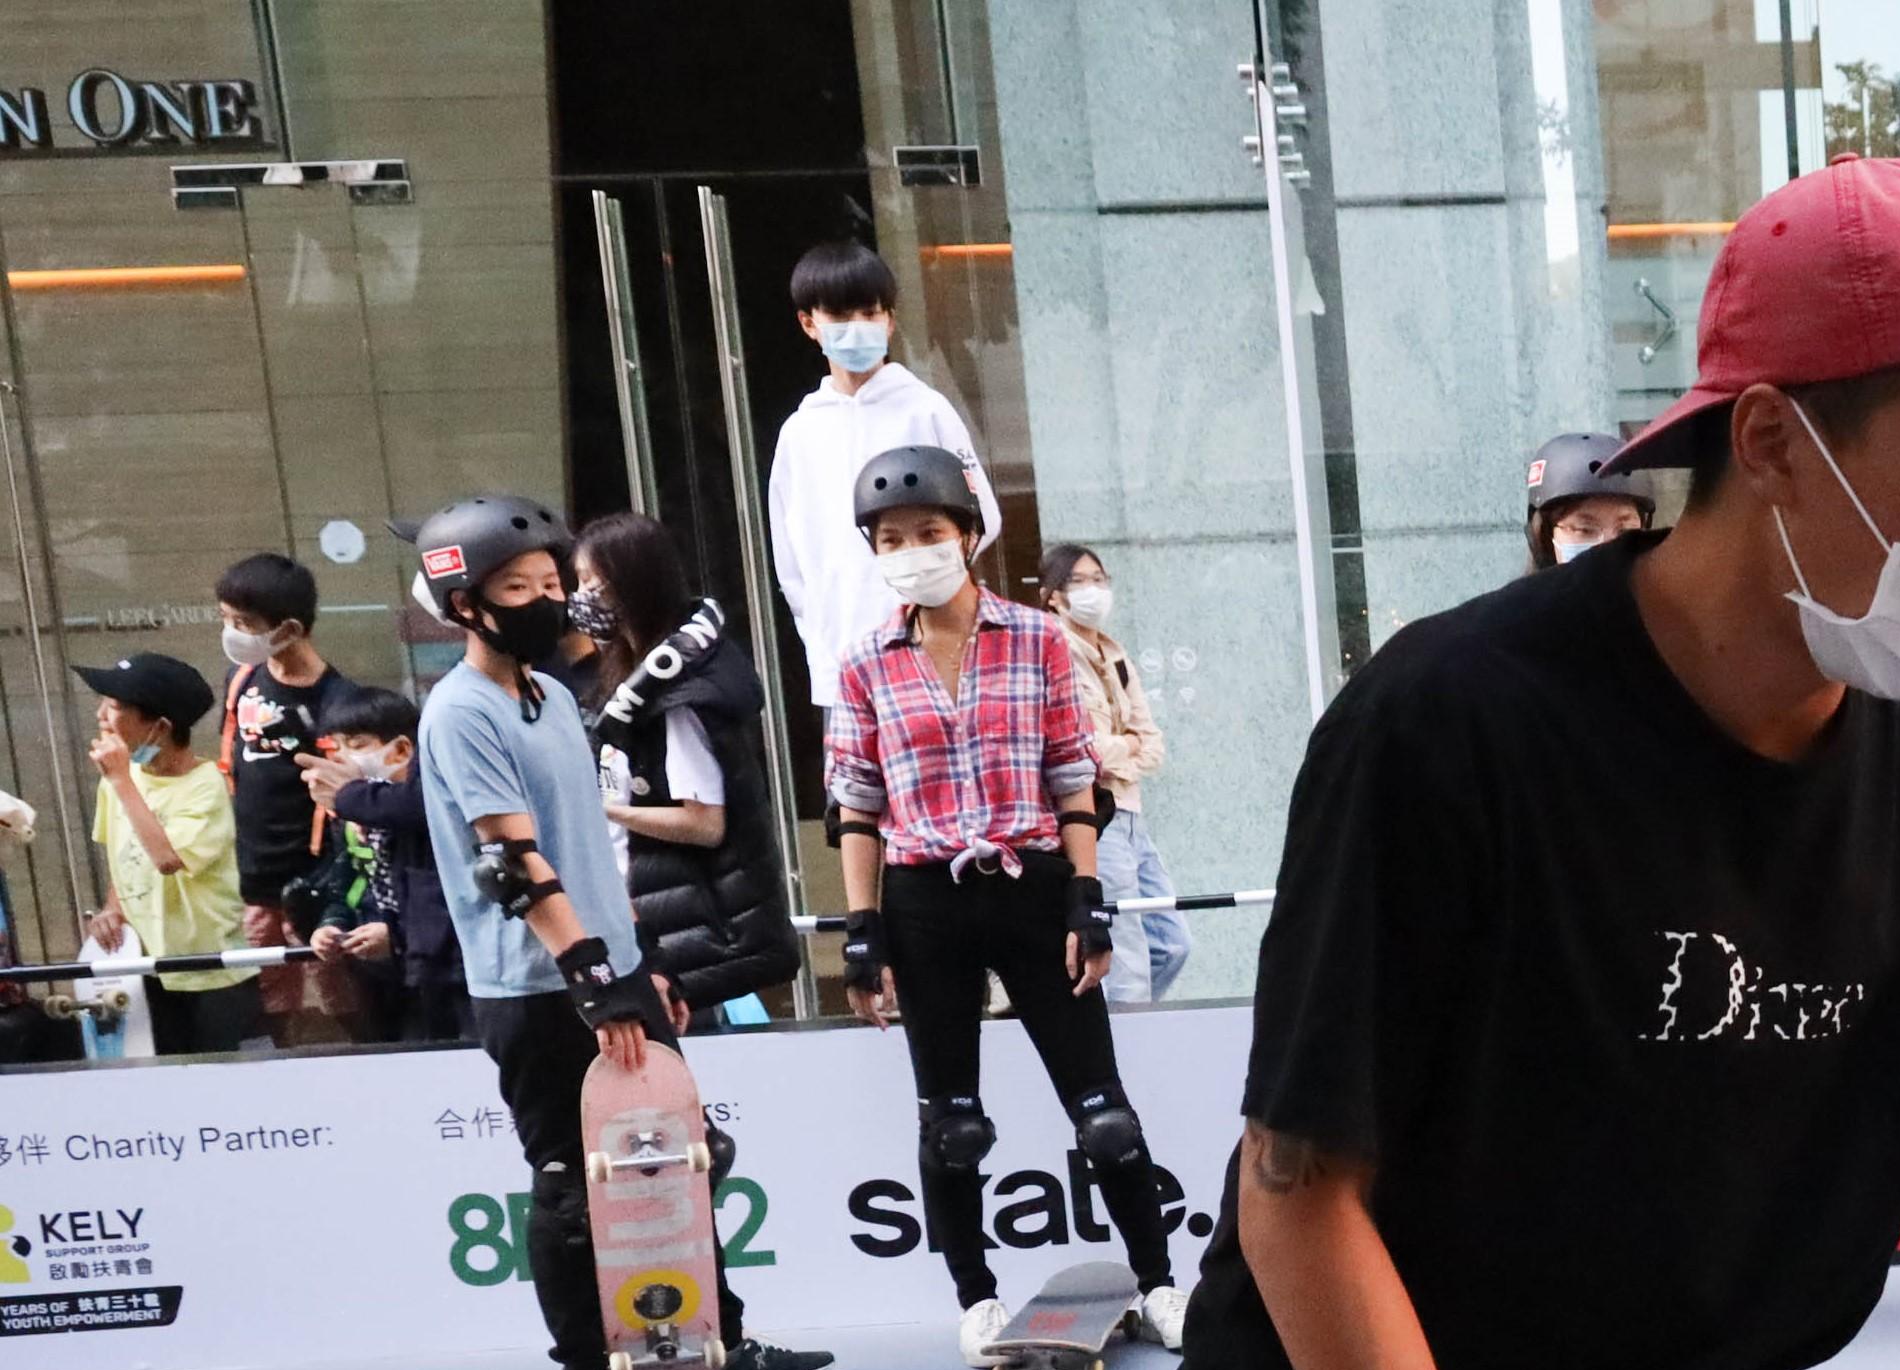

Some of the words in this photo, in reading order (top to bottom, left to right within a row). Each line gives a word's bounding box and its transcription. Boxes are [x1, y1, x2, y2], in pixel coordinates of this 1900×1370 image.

[68, 68, 254, 142] ONE
[434, 1106, 516, 1139] 合作
[65, 1130, 185, 1162] Charity
[199, 1125, 334, 1153] Partner:
[40, 1208, 144, 1243] KELY
[45, 1245, 104, 1258] SUPPORT
[106, 1243, 150, 1254] GROUP
[1, 1302, 49, 1316] YEARS
[51, 1301, 70, 1313] OF
[3, 1314, 51, 1330] YOUTH
[54, 1308, 163, 1327] EMPOWERMENT
